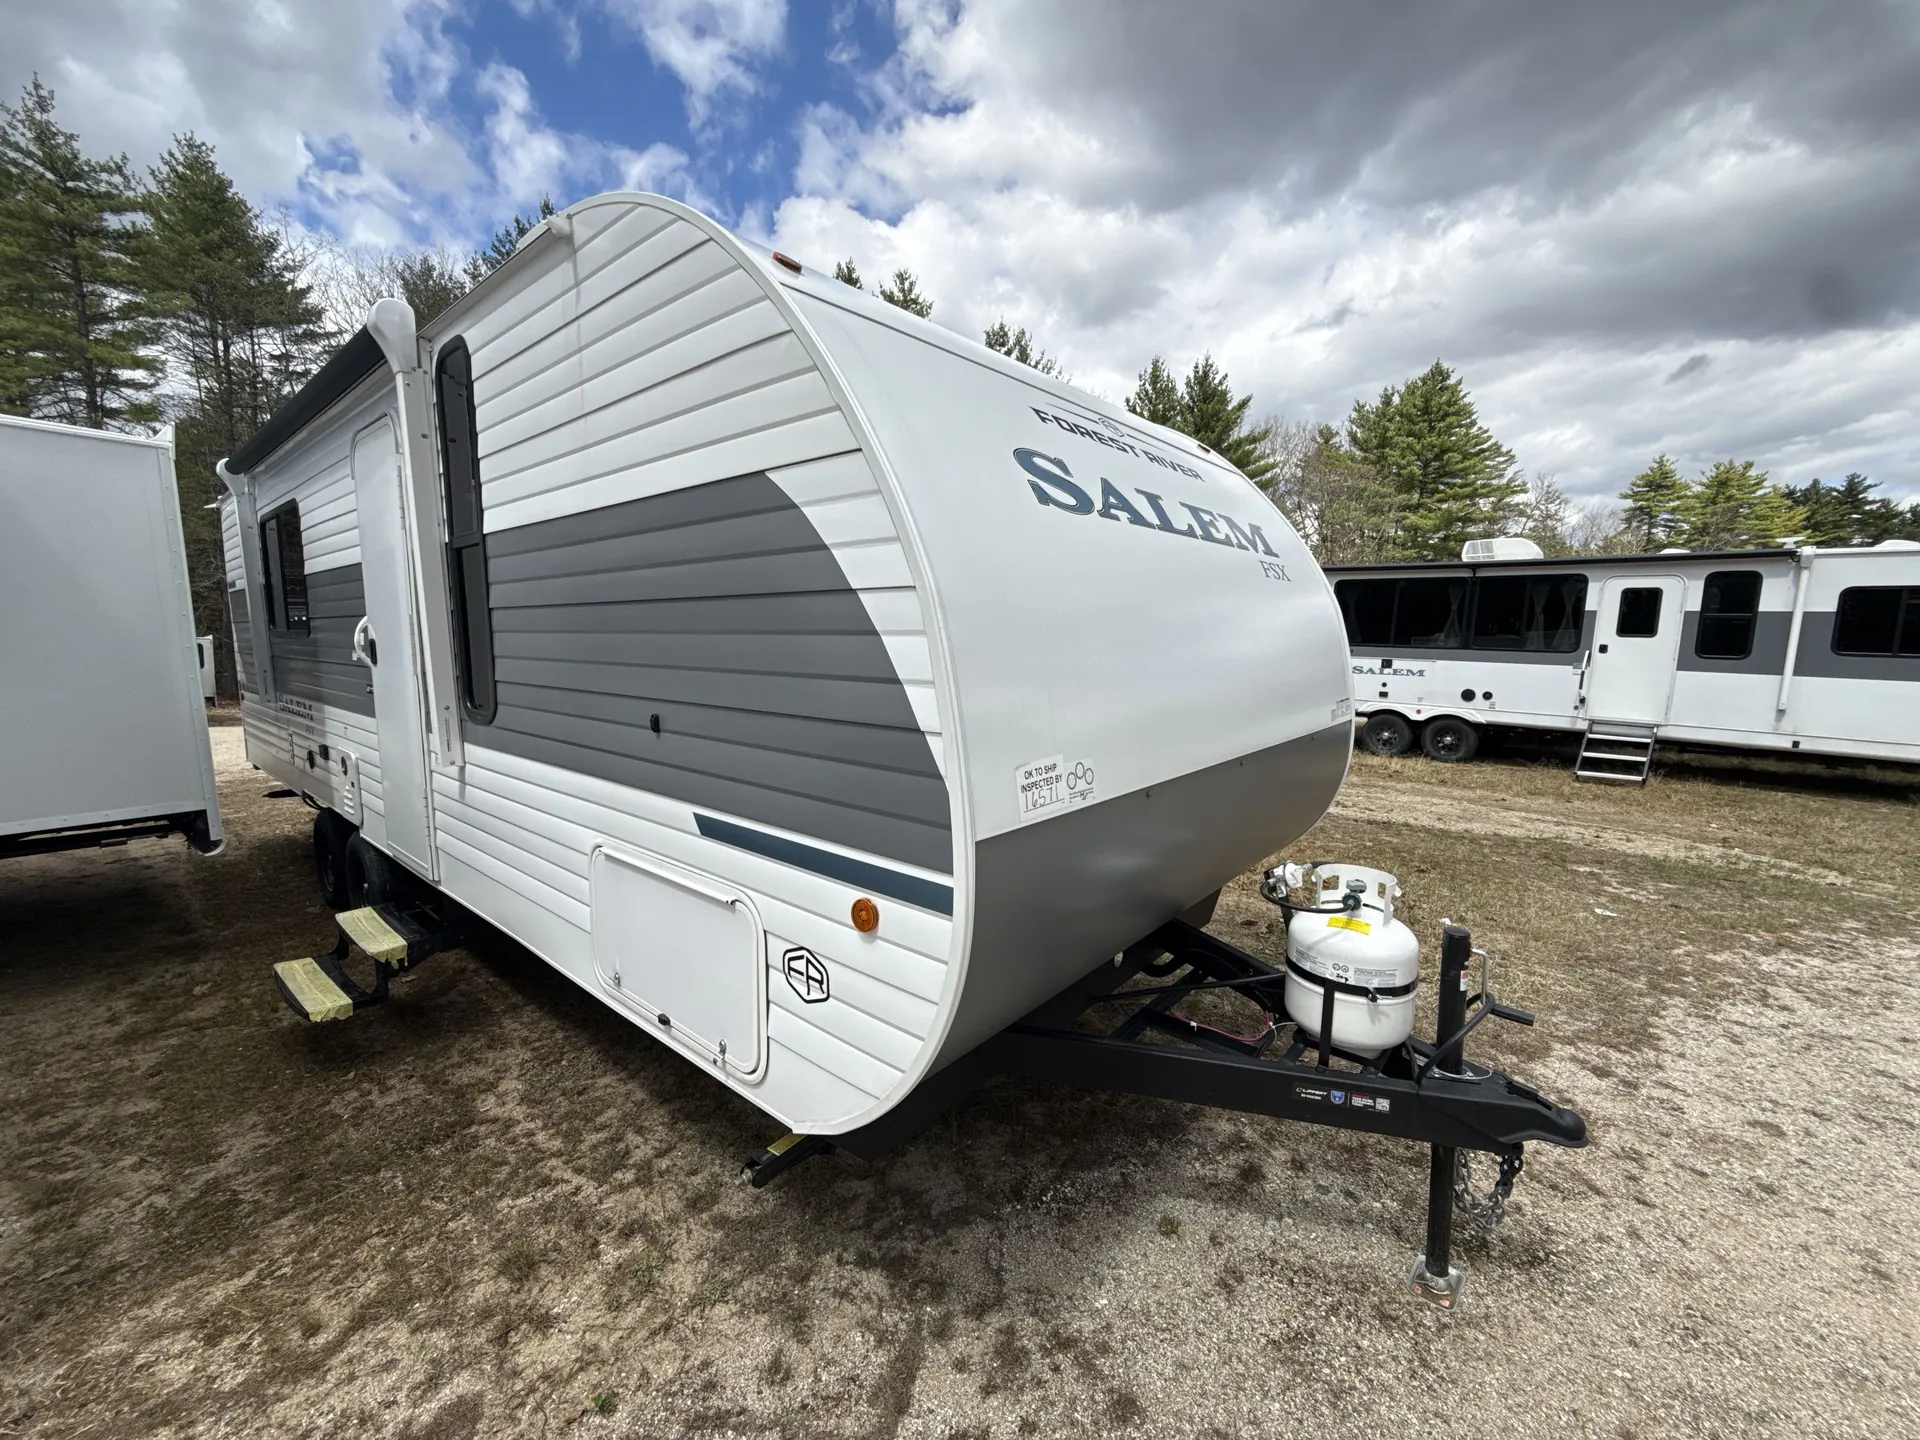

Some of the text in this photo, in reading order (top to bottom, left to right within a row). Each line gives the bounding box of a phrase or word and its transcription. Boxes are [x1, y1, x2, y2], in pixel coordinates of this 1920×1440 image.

[1028, 405, 1206, 483] FOREST RIVER
[1012, 447, 1280, 558] SALEM
[1258, 560, 1292, 582] FSX
[1352, 665, 1426, 677] SALEM
[1024, 763, 1057, 780] OK TO SHIP
[1020, 773, 1063, 793] INSPECTED BY
